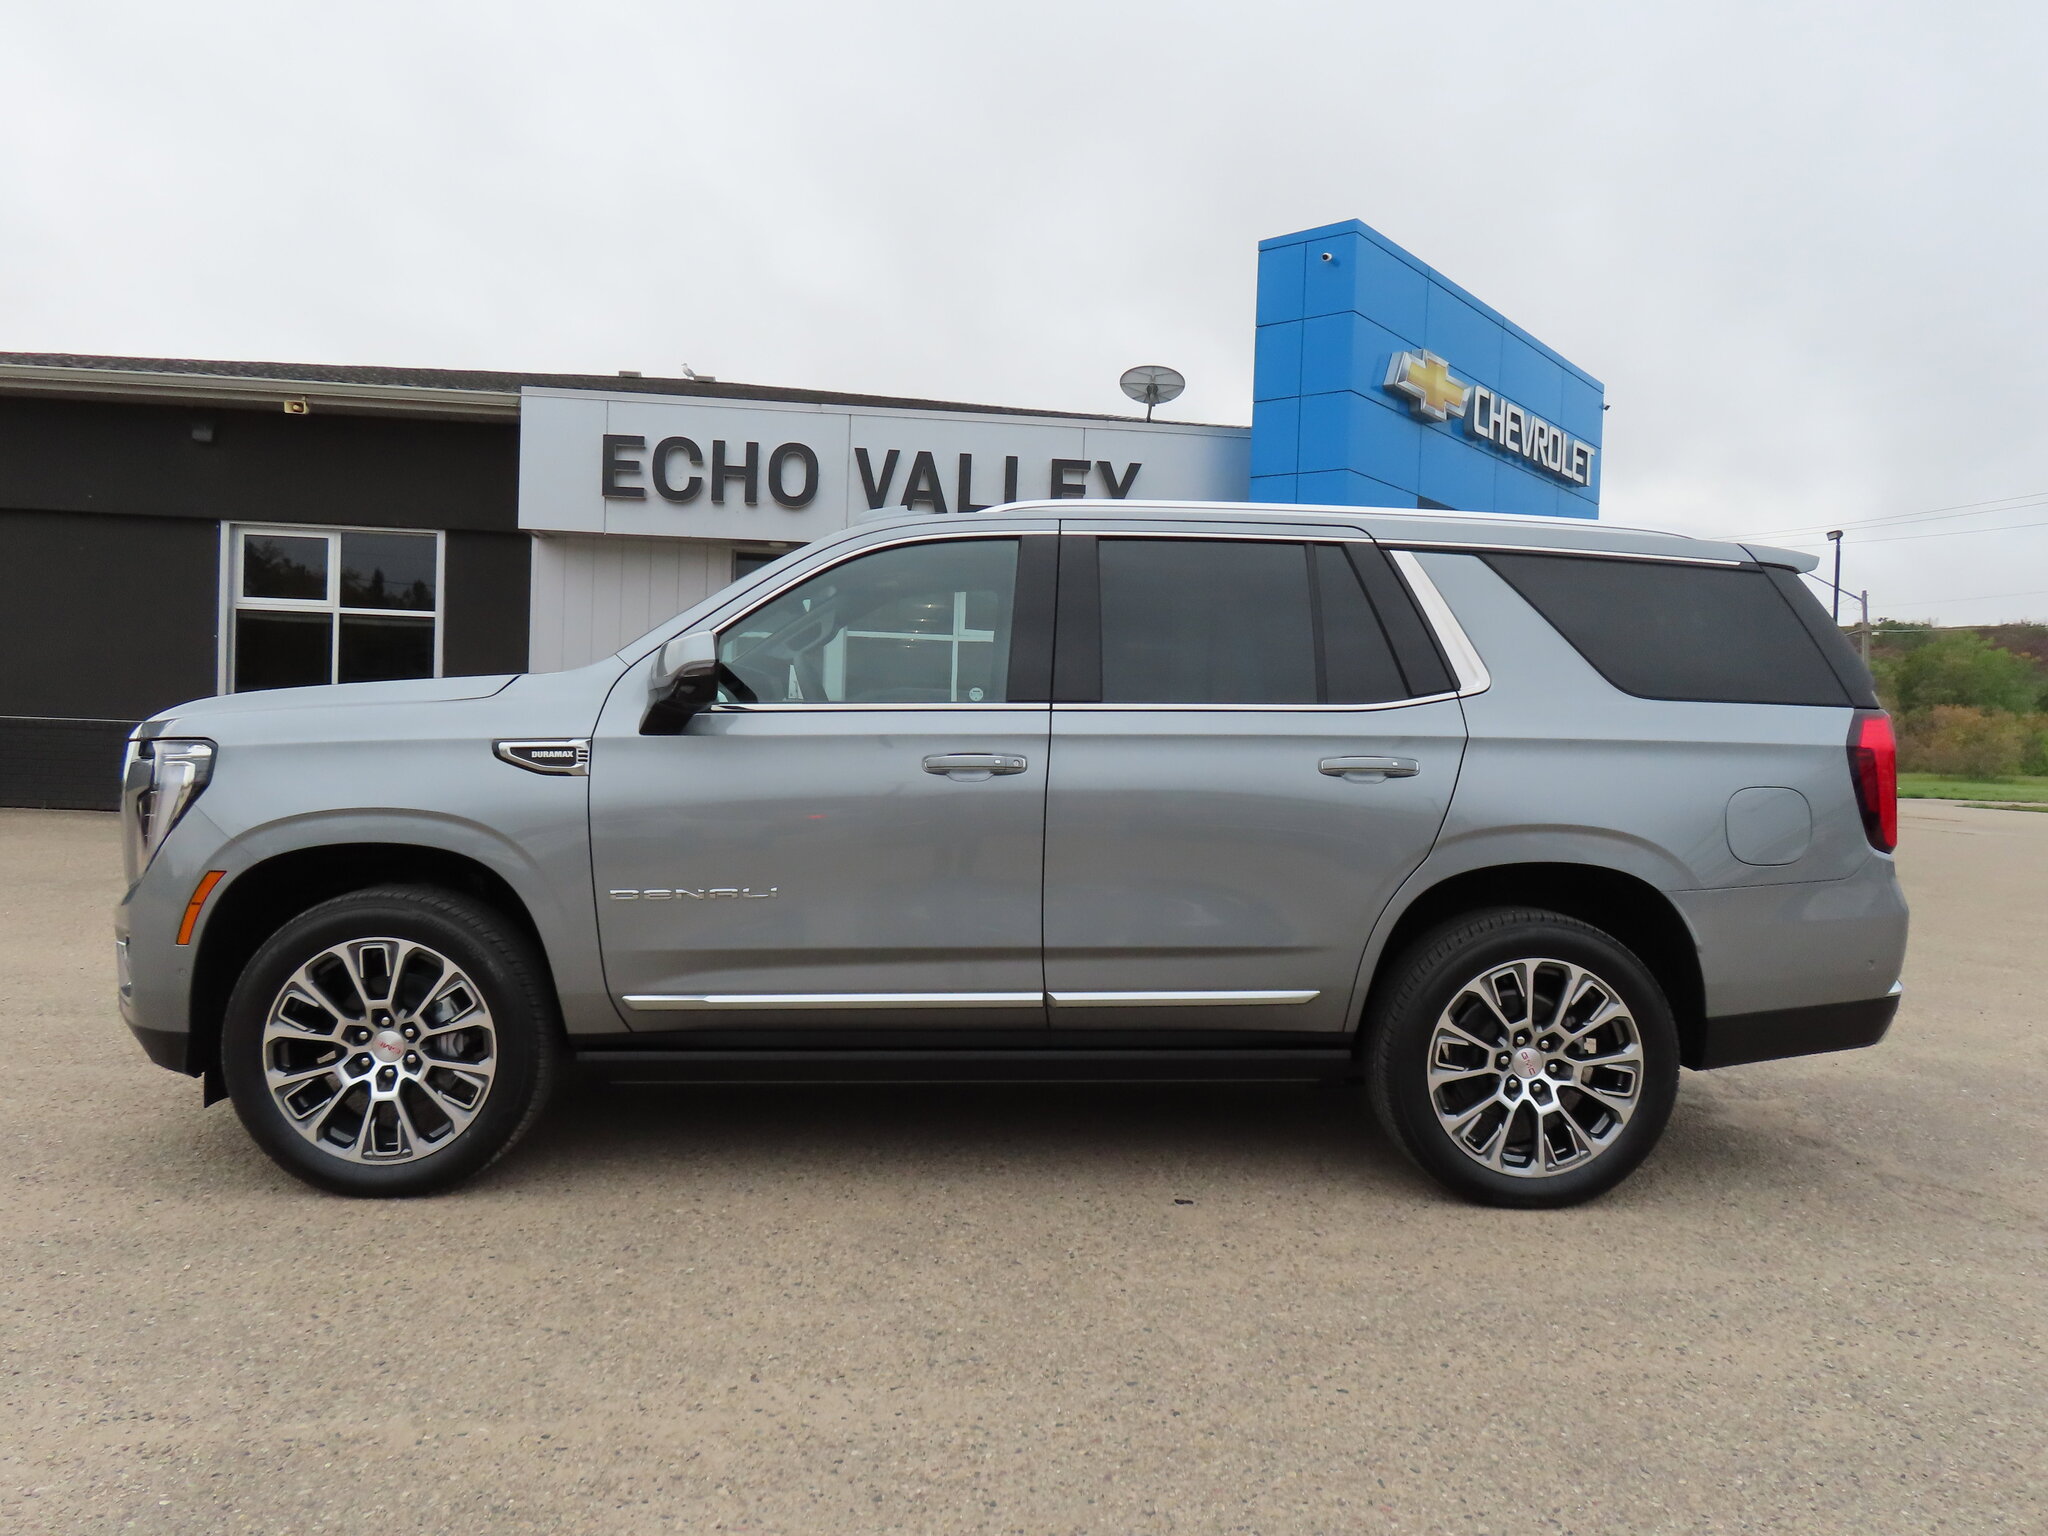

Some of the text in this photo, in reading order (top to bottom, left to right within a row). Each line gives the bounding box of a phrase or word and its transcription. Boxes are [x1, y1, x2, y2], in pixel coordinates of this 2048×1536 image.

[1473, 385, 1595, 486] CHEVROLET
[603, 434, 1142, 513] ECHO VALLEY
[531, 750, 574, 758] DURAMAX
[609, 887, 778, 900] DENALI
[1520, 1051, 1536, 1076] GMC
